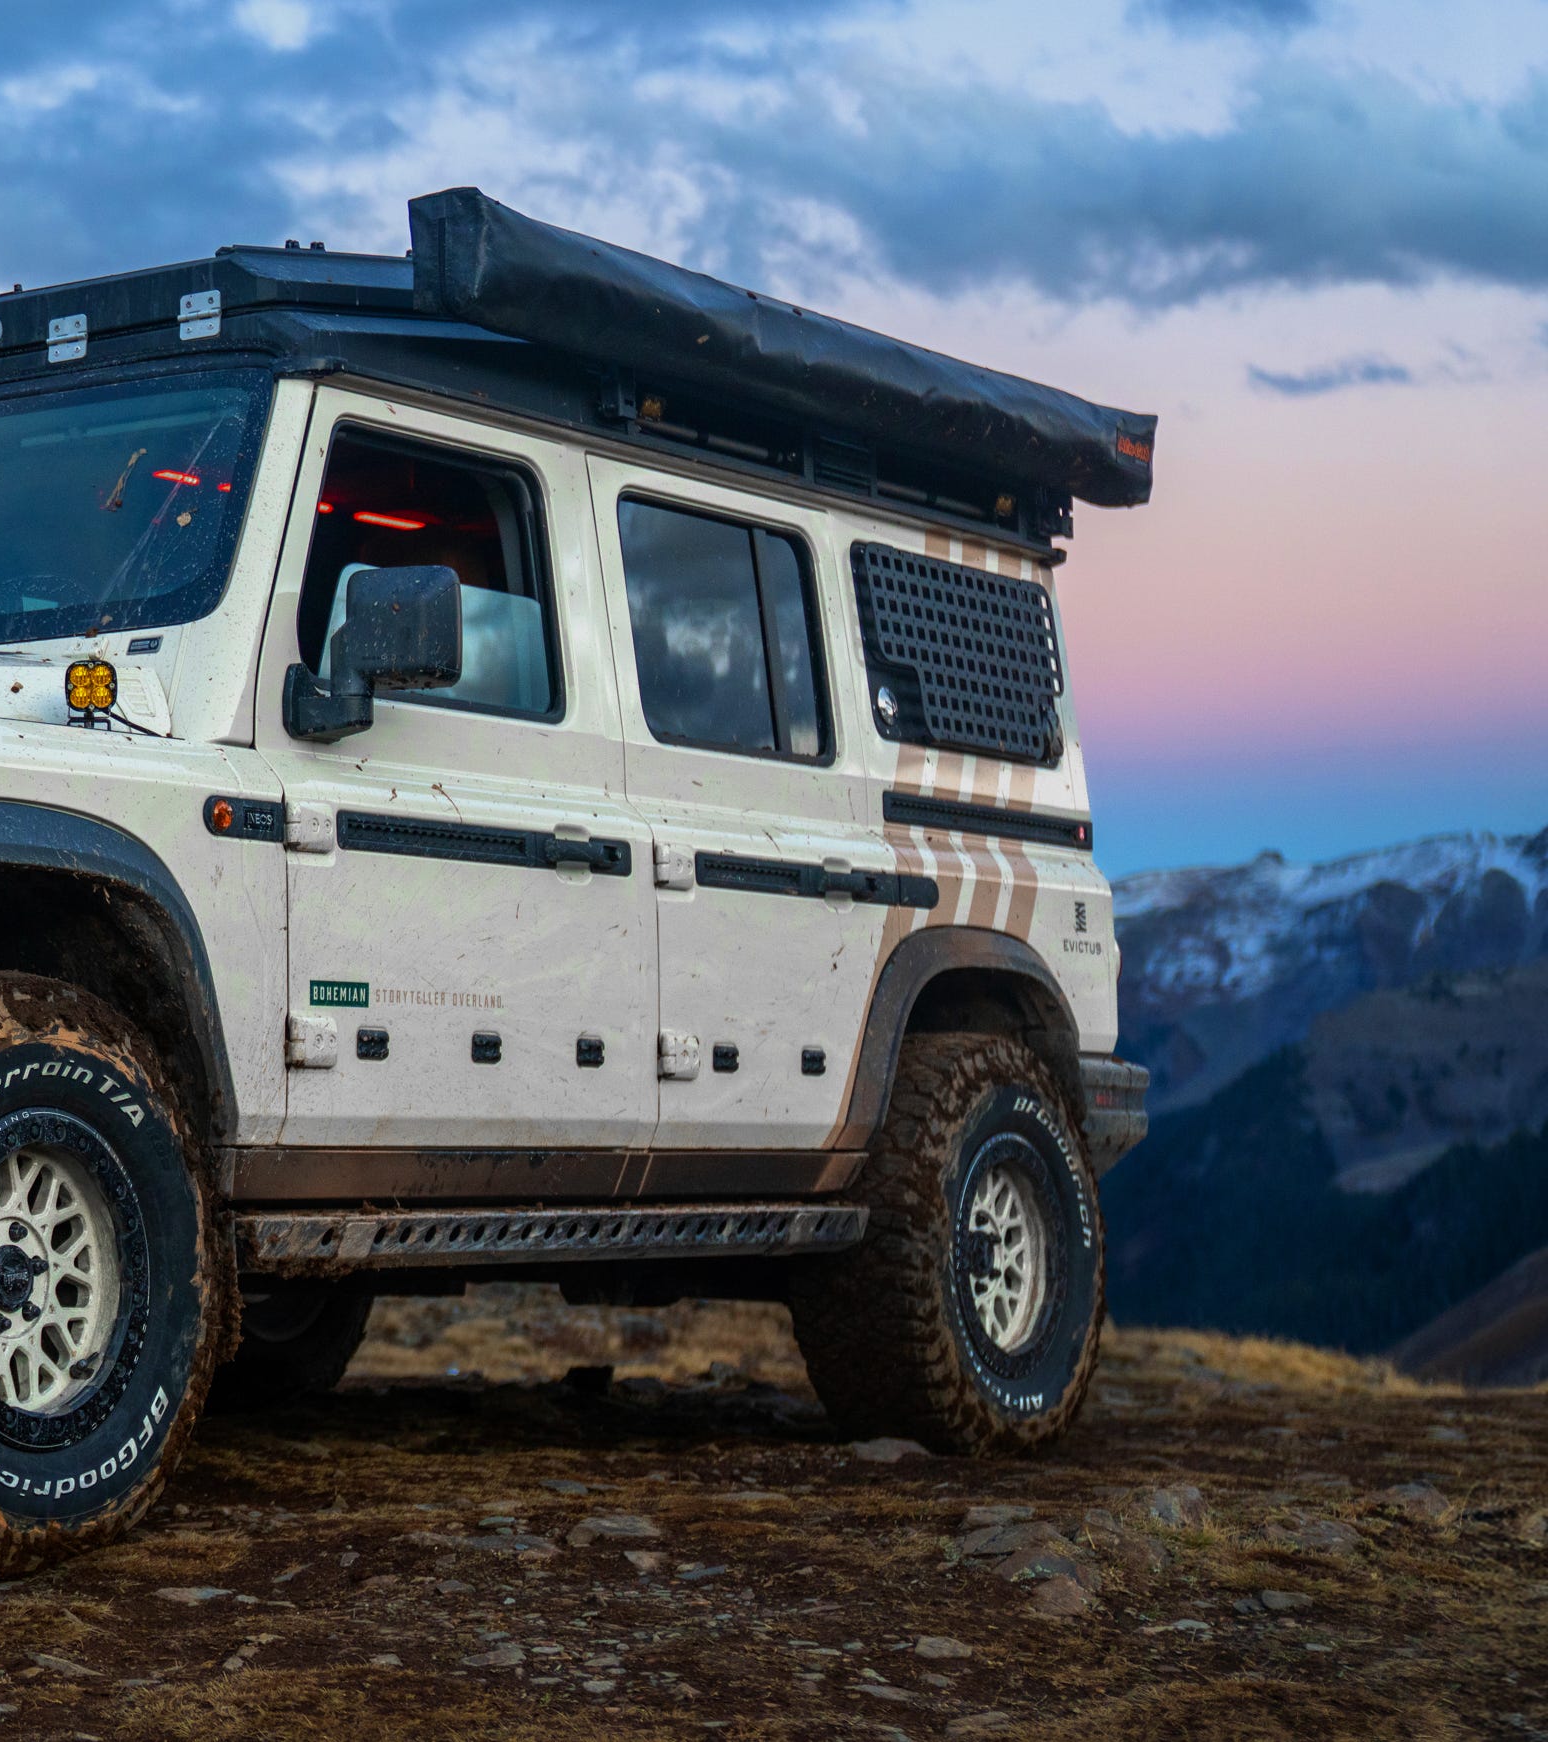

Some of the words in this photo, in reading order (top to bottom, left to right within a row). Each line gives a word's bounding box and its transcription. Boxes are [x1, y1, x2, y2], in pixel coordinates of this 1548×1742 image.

[247, 812, 273, 825] INEOS
[1063, 939, 1102, 956] EVICTUS
[313, 985, 366, 1003] BOHEMIAN
[375, 988, 446, 1006] STORYTELLER
[98, 1074, 146, 1128] T/A
